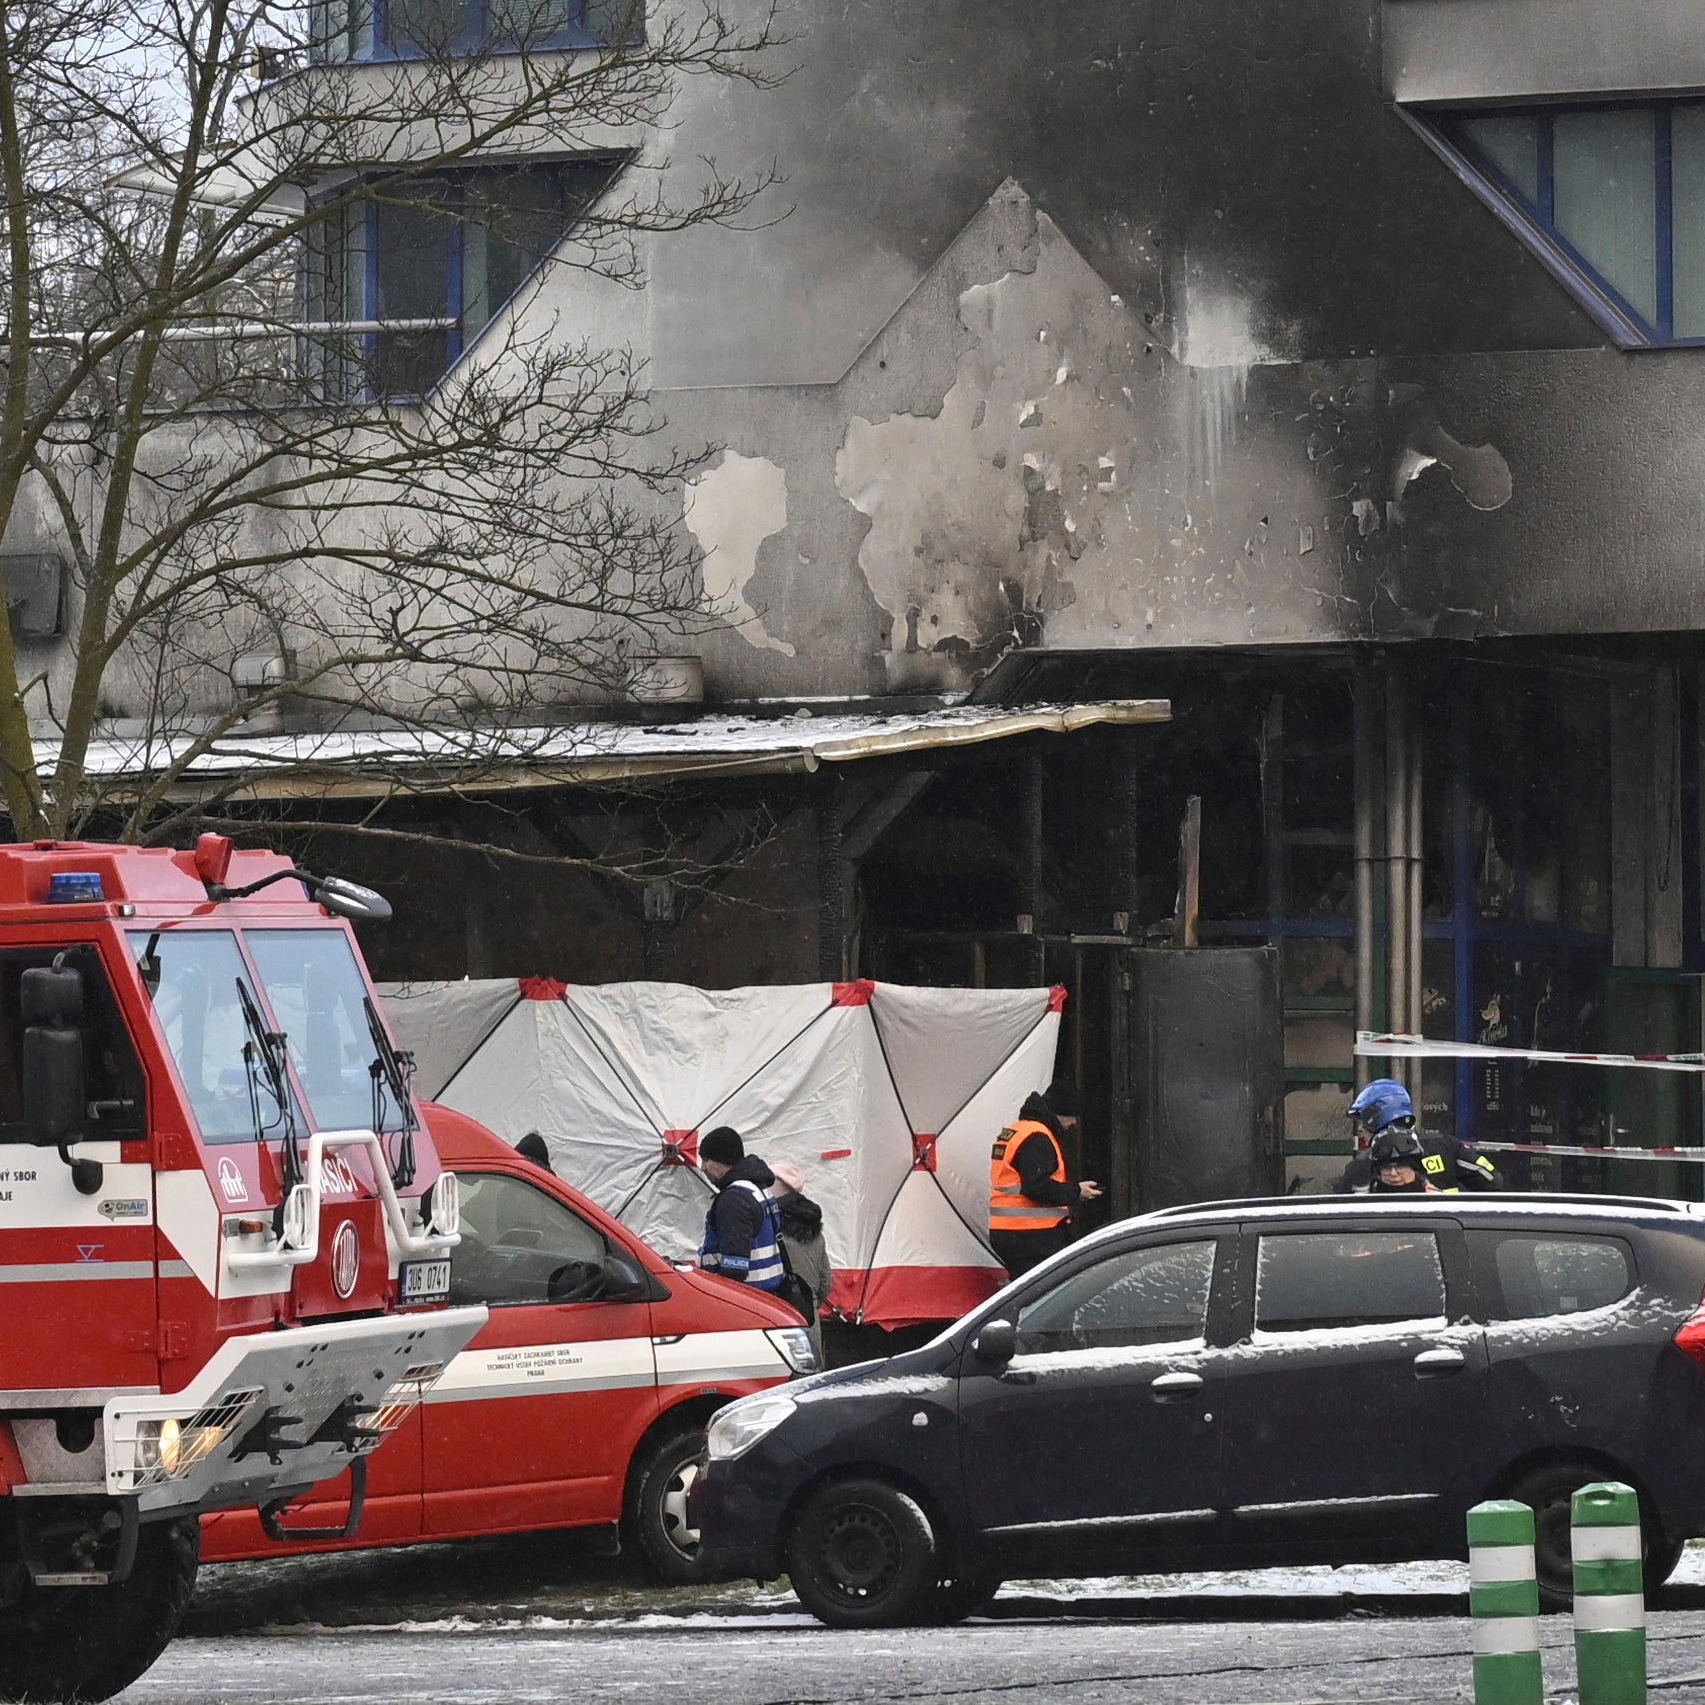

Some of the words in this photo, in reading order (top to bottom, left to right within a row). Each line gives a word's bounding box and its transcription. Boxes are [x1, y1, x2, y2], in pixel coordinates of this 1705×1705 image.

[13, 1171, 37, 1181] SBOR
[116, 1201, 145, 1211] OnAir
[427, 1264, 447, 1290] 0741
